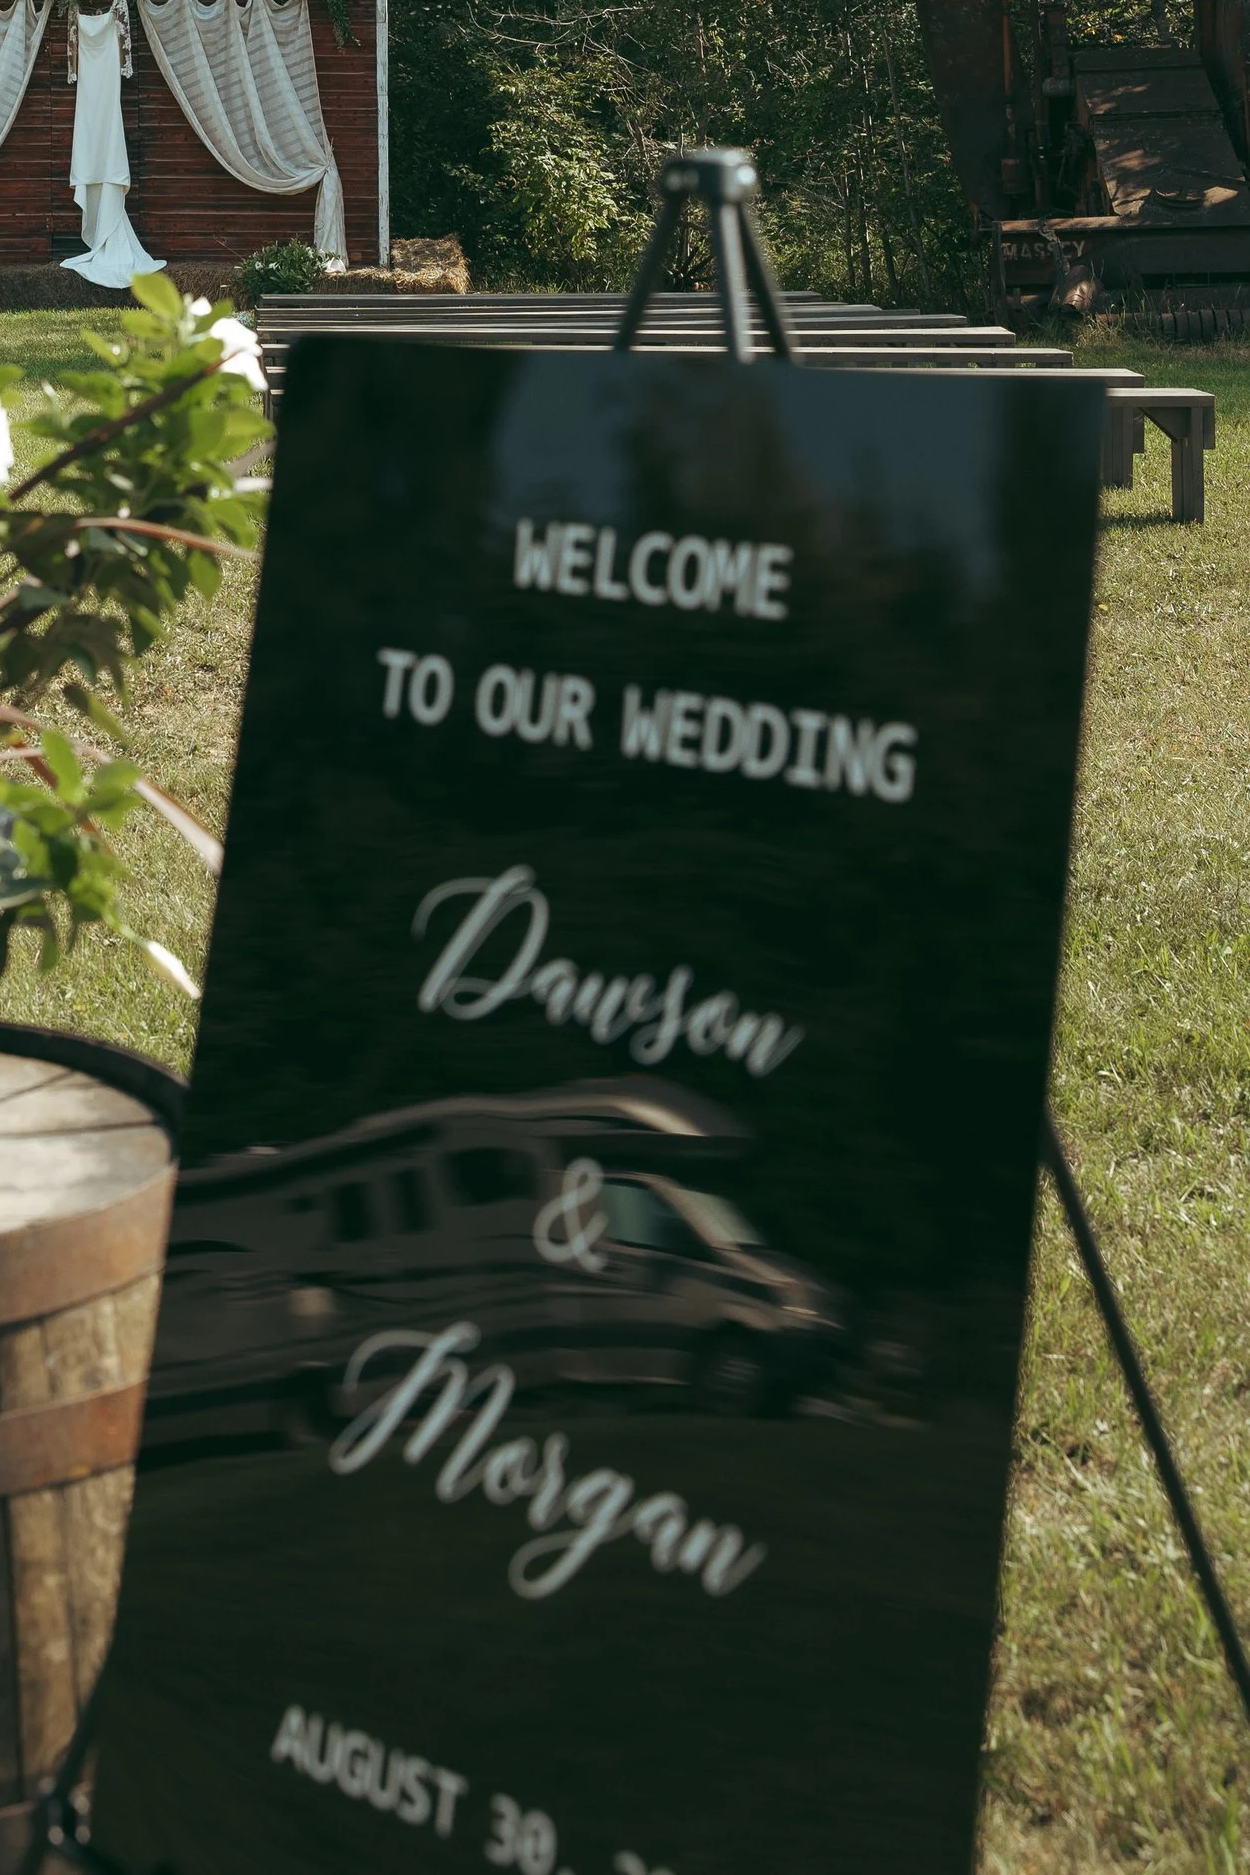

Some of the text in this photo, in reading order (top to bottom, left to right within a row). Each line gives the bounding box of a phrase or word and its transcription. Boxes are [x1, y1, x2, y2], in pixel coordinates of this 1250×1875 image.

[514, 517, 793, 620] WELCOME
[377, 647, 917, 803] TO OUR WEDDING
[413, 864, 802, 1075] Dawson
[534, 1158, 608, 1272] &
[330, 1322, 766, 1598] Morgan
[270, 1704, 469, 1836] AUGUST
